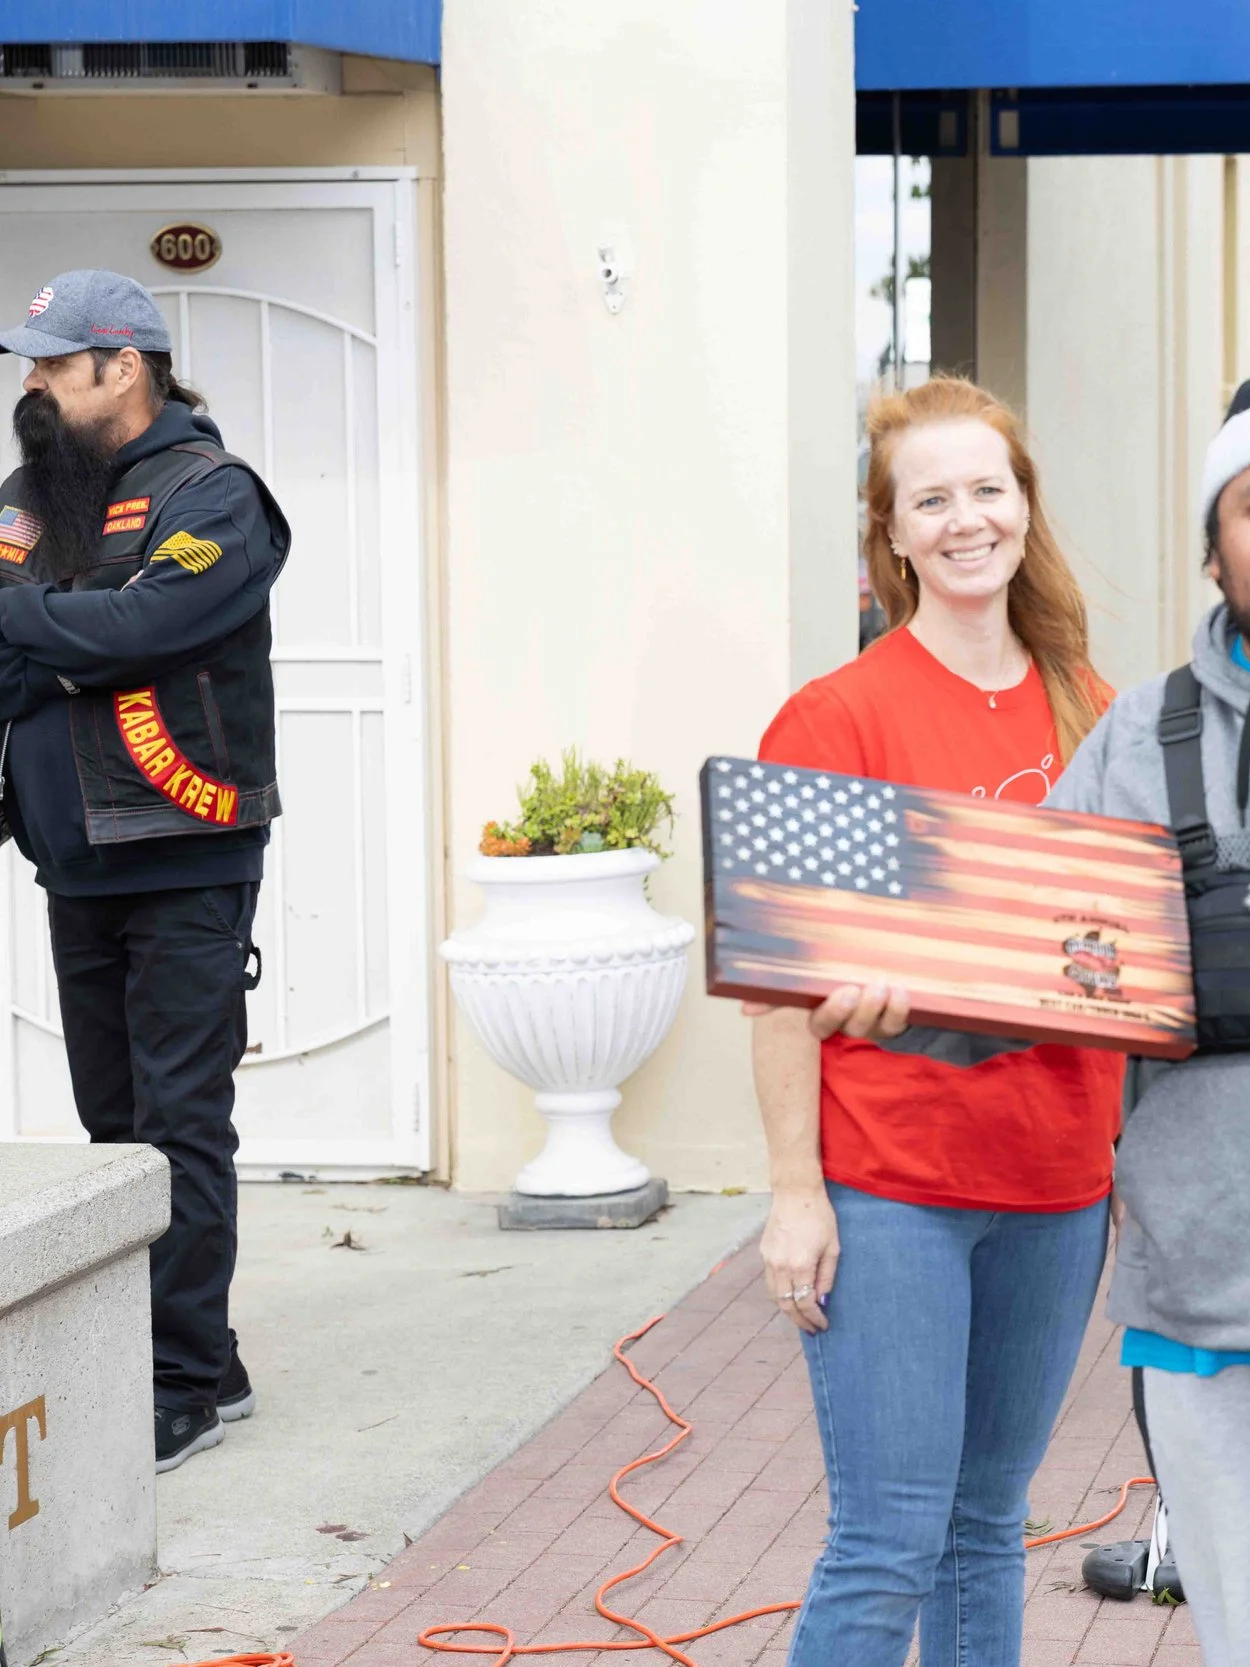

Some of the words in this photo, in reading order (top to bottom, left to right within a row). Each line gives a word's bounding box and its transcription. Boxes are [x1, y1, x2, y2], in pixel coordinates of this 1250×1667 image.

[160, 233, 210, 261] 600
[107, 517, 142, 532] OAKLAND
[118, 691, 176, 777] KABAR
[163, 763, 235, 822] KREW
